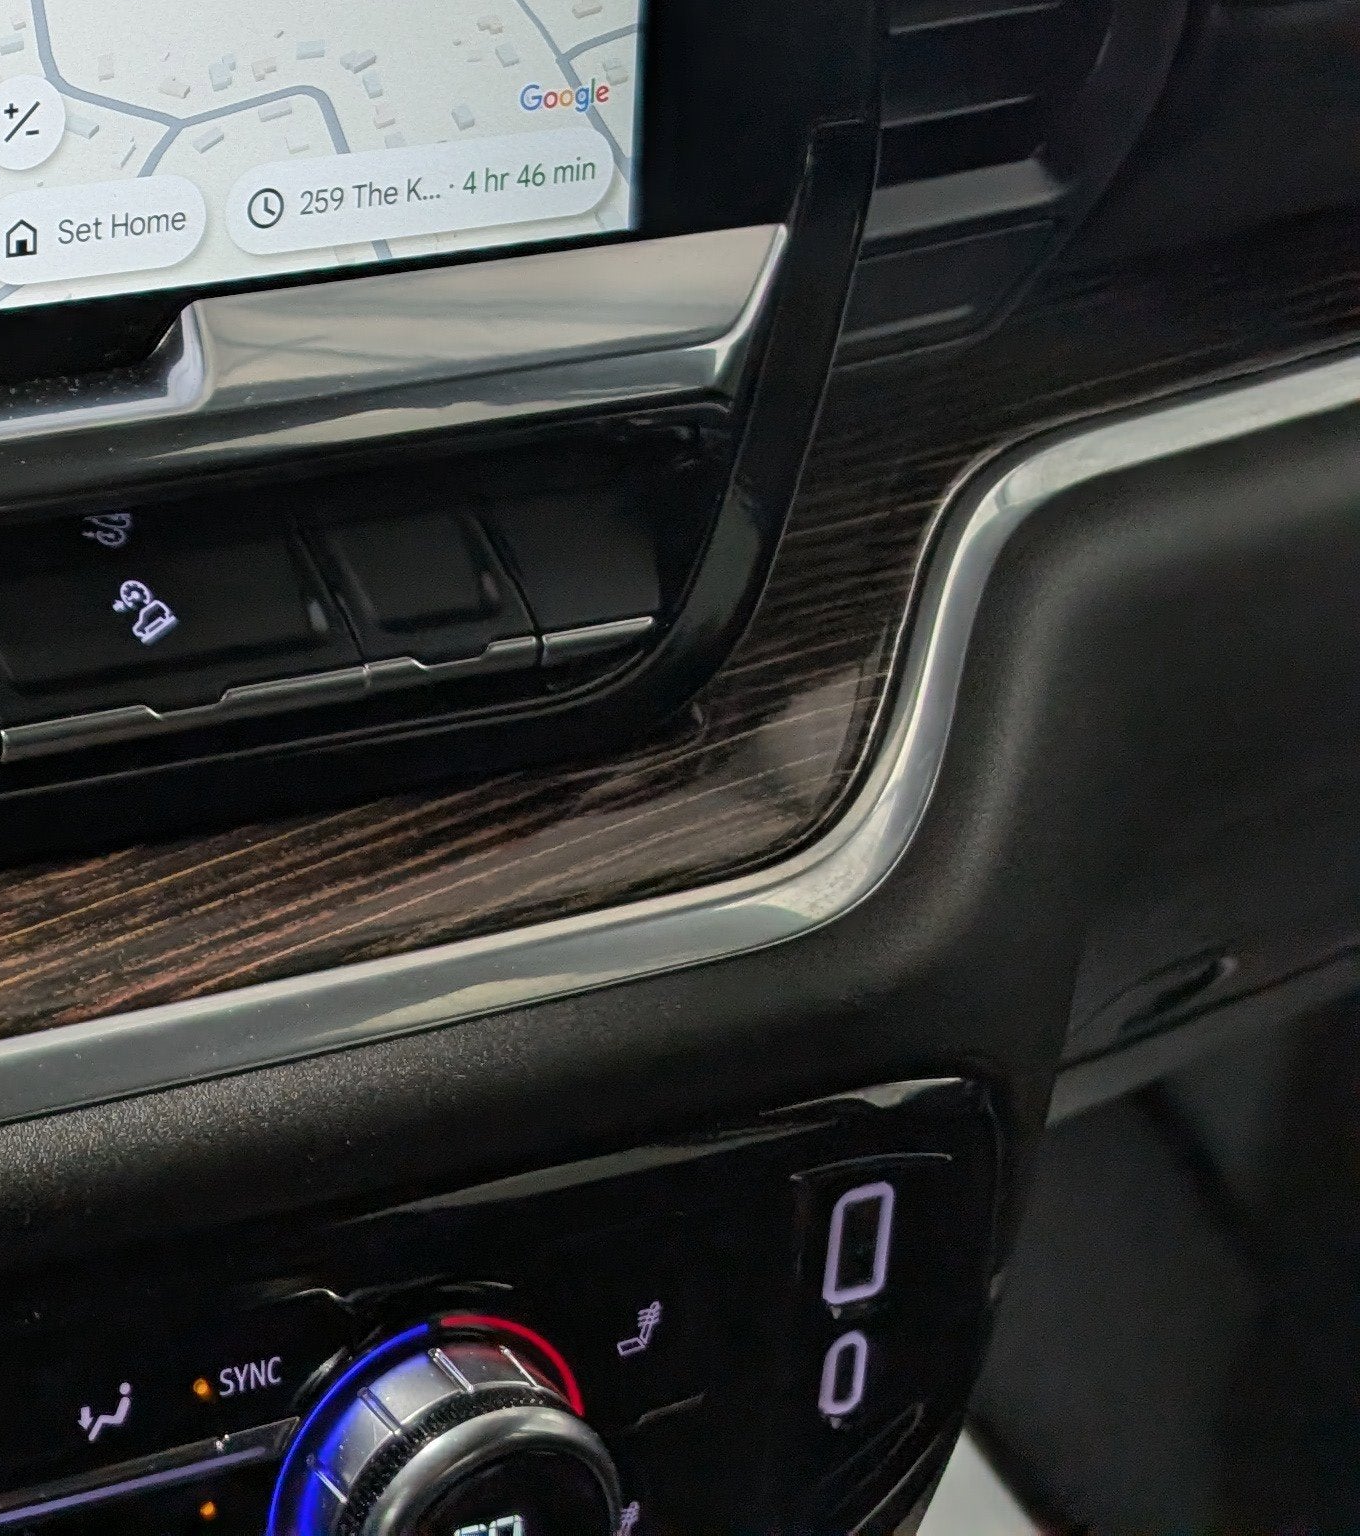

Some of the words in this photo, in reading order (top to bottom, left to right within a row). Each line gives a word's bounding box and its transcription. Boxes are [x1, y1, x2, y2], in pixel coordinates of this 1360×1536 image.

[519, 80, 611, 113] Google
[299, 186, 346, 216] 259
[351, 180, 400, 210] The
[461, 170, 478, 196] 4
[483, 166, 511, 194] hr
[515, 163, 547, 189] 46
[552, 156, 597, 184] min
[57, 216, 104, 245] Set
[110, 209, 188, 240] Home
[219, 1356, 282, 1396] SYNC
